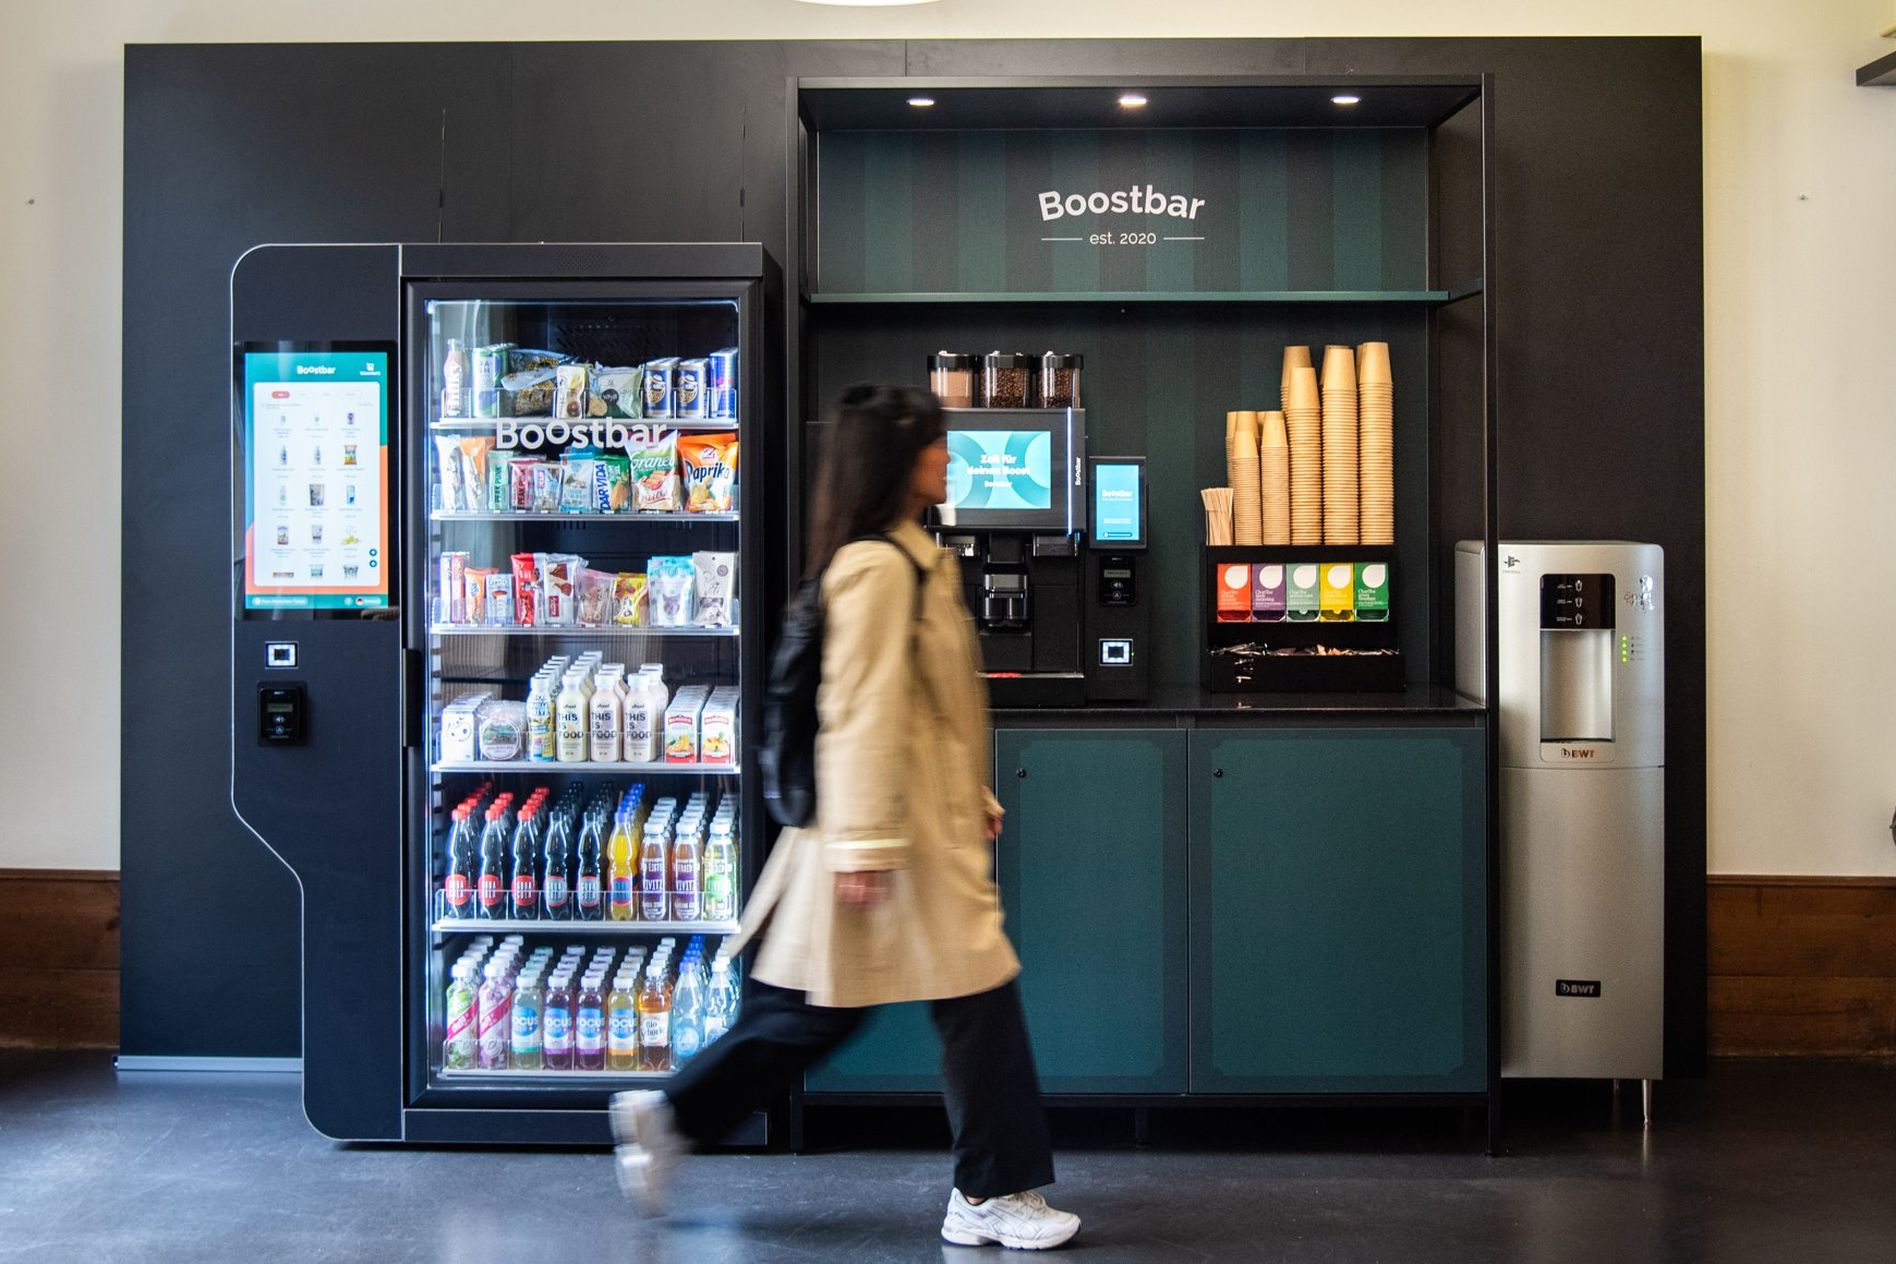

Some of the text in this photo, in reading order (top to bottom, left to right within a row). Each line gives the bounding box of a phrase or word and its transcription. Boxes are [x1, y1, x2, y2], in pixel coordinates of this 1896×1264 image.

[1038, 184, 1206, 222] Boostbar
[1089, 232, 1157, 245] est. 2020
[296, 365, 336, 375] Boostbar
[496, 417, 667, 450] Boostbar
[685, 460, 730, 483] Paprika
[1074, 457, 1082, 487] Boostbar
[591, 712, 611, 721] THIS
[592, 730, 617, 739] FOOD
[1571, 984, 1594, 993] BWT
